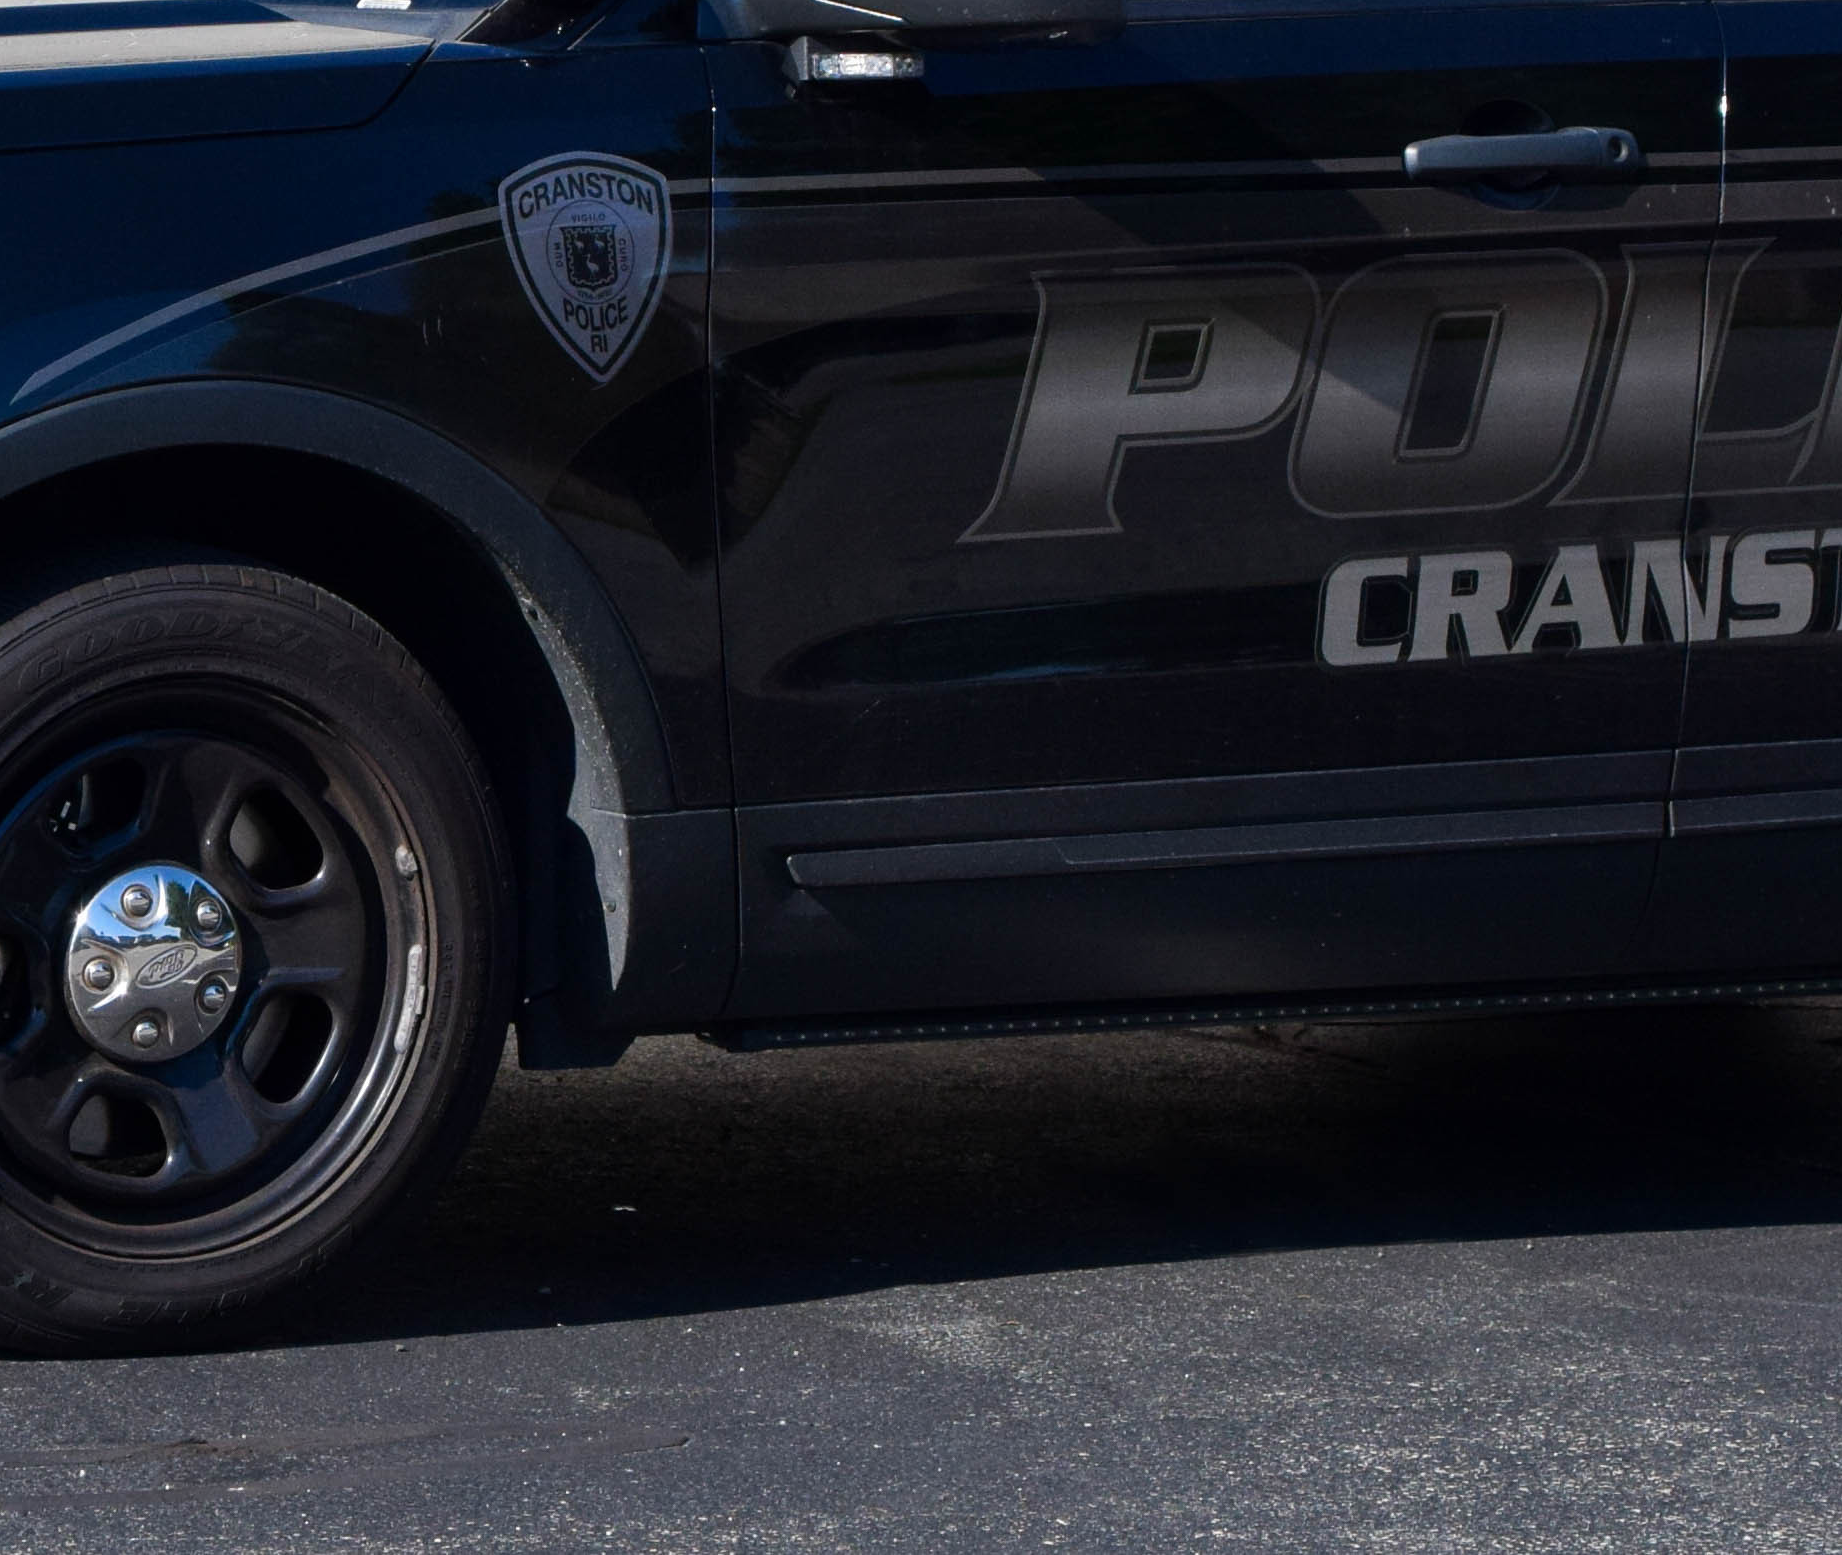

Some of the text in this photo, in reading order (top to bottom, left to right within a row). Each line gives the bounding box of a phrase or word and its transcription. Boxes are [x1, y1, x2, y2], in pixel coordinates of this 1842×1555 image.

[518, 172, 654, 219] CRANSTON
[563, 297, 629, 332] POLICE
[590, 333, 608, 353] RI
